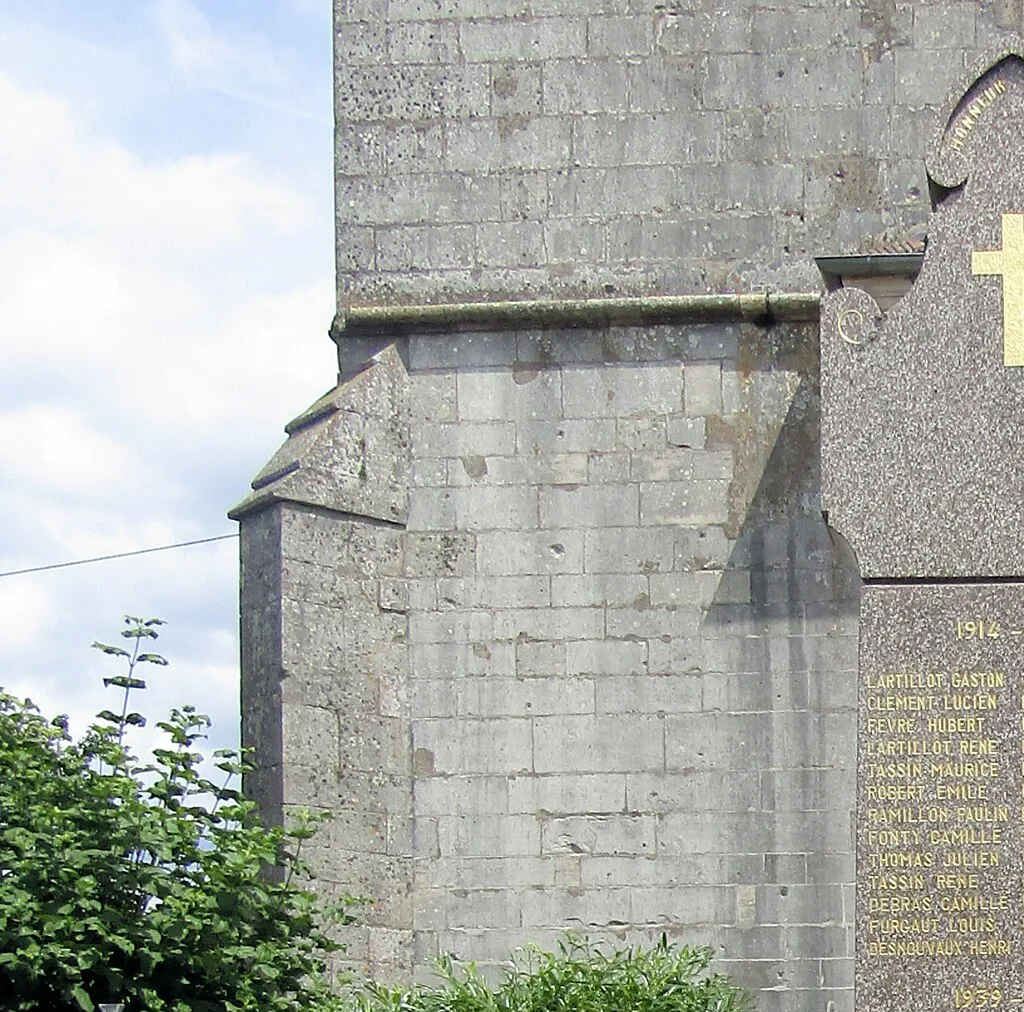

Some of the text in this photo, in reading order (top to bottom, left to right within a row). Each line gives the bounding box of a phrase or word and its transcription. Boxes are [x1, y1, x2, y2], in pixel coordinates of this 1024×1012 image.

[950, 79, 1006, 151] HONNEUR
[956, 619, 1000, 640] 1914
[866, 672, 1005, 689] LARTILLOT GASTON
[867, 694, 998, 711] CLEMENT LUCIEN
[867, 717, 985, 733] FEVRE HUBERT
[867, 740, 999, 756] LARTILLOT RENE
[868, 762, 999, 778] TASSIN MAURICE
[867, 785, 988, 800] ROBERT EMILE
[868, 807, 1009, 823] RAMILLON PAULIN
[868, 829, 1002, 846] FONTY CAMILLE
[868, 852, 1000, 867] THOMAS JULIEN
[868, 874, 979, 890] TASSIN RENE
[868, 896, 1009, 912] DEBRAS CAMILLE
[948, 917, 995, 933] LOUIS
[969, 939, 1013, 955] HENRI
[955, 988, 1001, 1008] 1939
